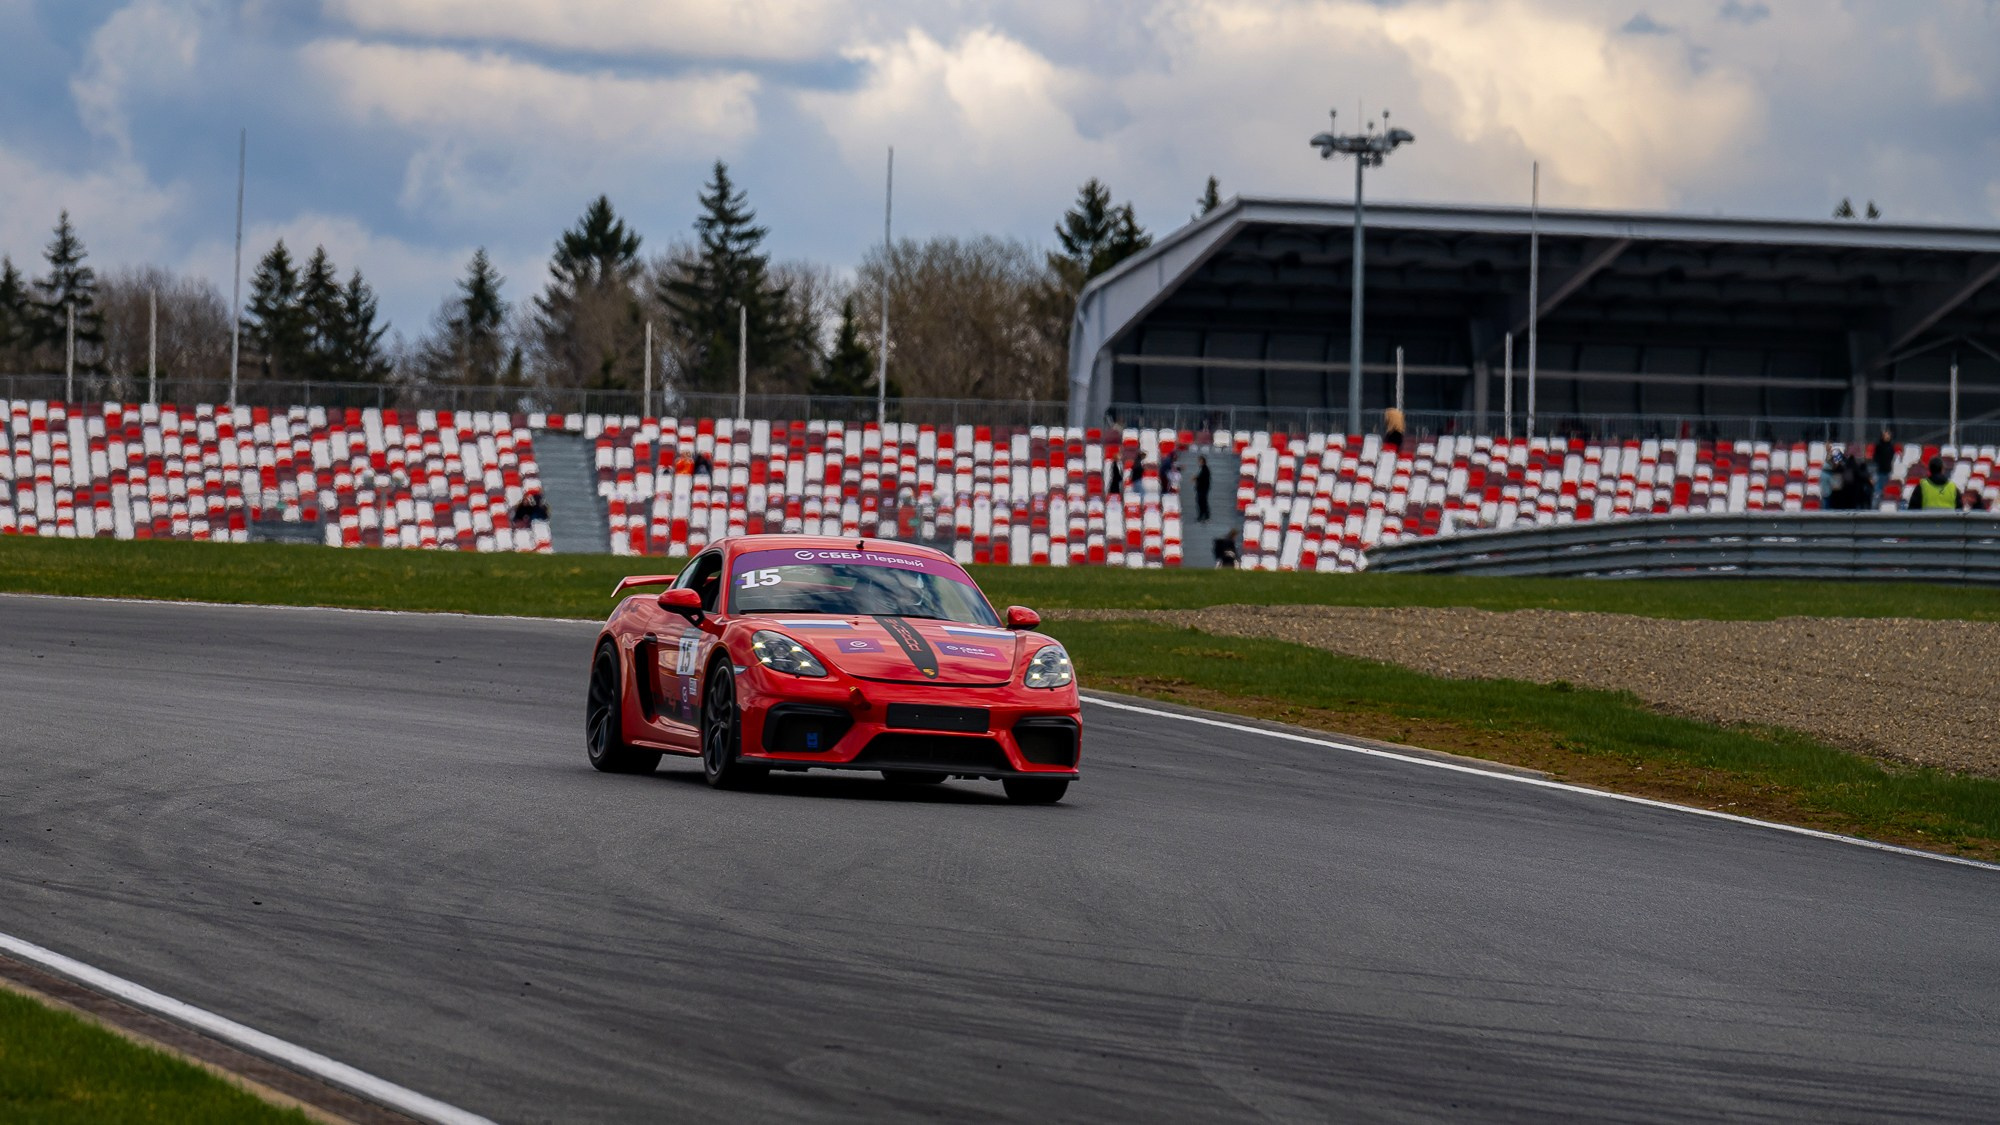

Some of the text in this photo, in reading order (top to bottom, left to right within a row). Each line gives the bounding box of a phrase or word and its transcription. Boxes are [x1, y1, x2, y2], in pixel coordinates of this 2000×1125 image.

[818, 551, 924, 568] СБЕР Первый
[741, 568, 782, 589] 15
[680, 641, 693, 673] 15
